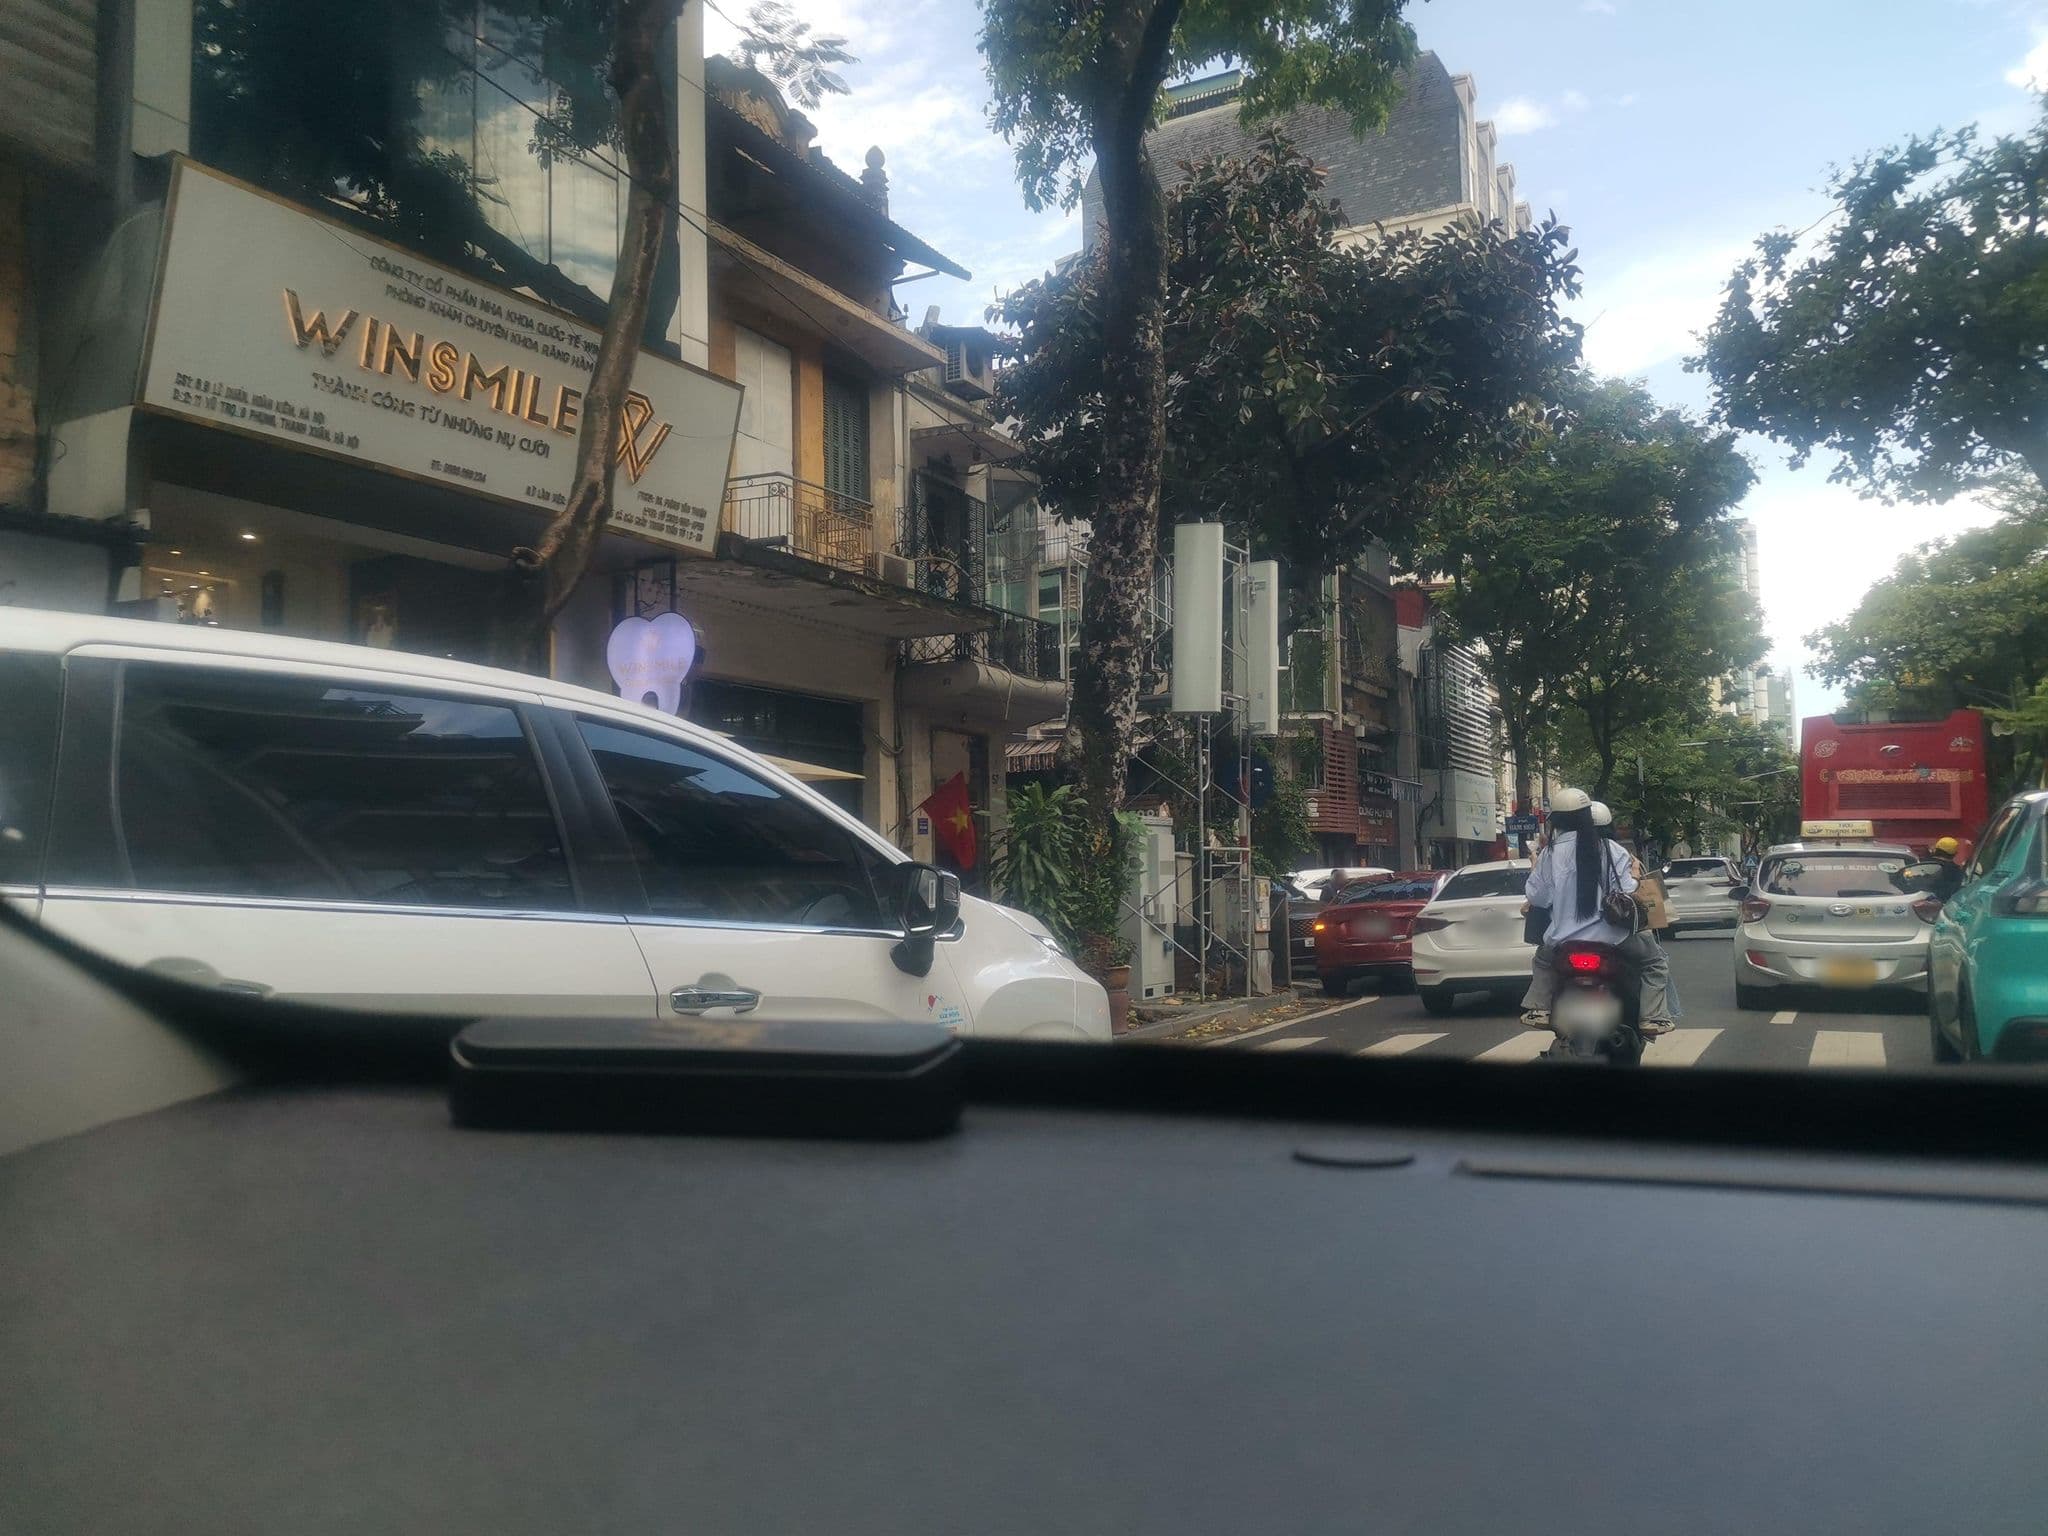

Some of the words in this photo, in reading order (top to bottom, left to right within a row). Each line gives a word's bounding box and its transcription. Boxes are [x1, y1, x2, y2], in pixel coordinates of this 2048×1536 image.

[370, 256, 404, 278] CÔNG
[407, 270, 424, 285] TY
[445, 285, 477, 308] PHẦN
[479, 300, 502, 319] NHA
[506, 309, 534, 330] KHOA
[537, 322, 565, 341] QUỐC
[568, 334, 583, 348] TẾ
[385, 284, 426, 309] PHÒNG
[429, 301, 463, 324] KHÁM
[465, 315, 509, 339] CHUYÊN
[511, 332, 539, 353] KHOA
[283, 287, 583, 437] WINSMILE
[312, 372, 368, 403] THÀNH
[371, 391, 416, 418] CÔNG
[419, 404, 442, 424] TỪ
[443, 415, 493, 441] NHỮNG
[496, 430, 516, 450] NỤ
[519, 437, 550, 459] CƯỜI
